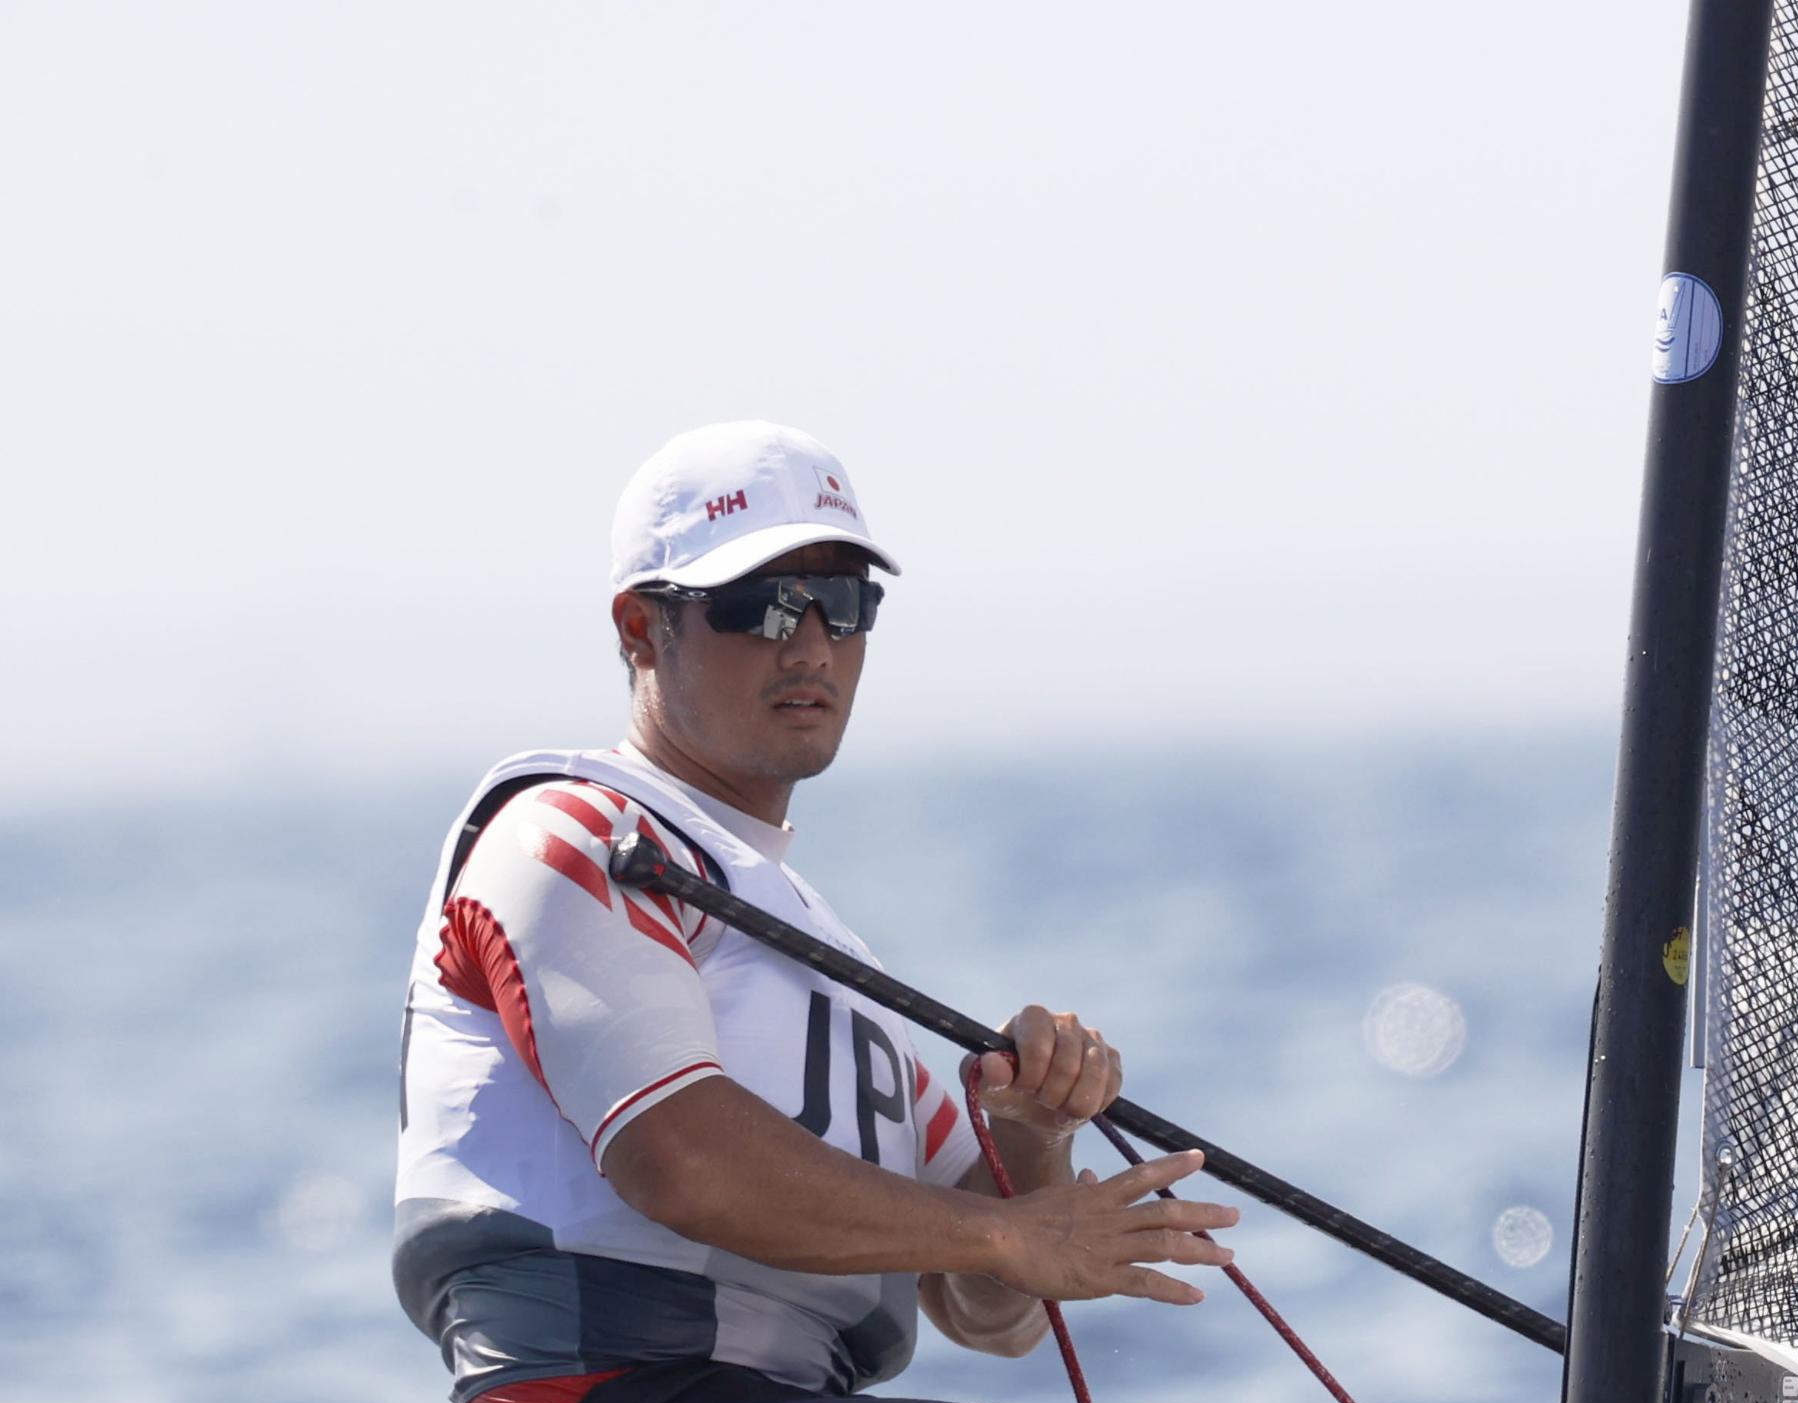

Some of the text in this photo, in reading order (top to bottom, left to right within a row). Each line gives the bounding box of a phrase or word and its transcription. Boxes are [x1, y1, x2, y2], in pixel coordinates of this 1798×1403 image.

[706, 489, 748, 522] HH
[814, 494, 858, 520] JAPAN
[793, 990, 916, 1166] JP
